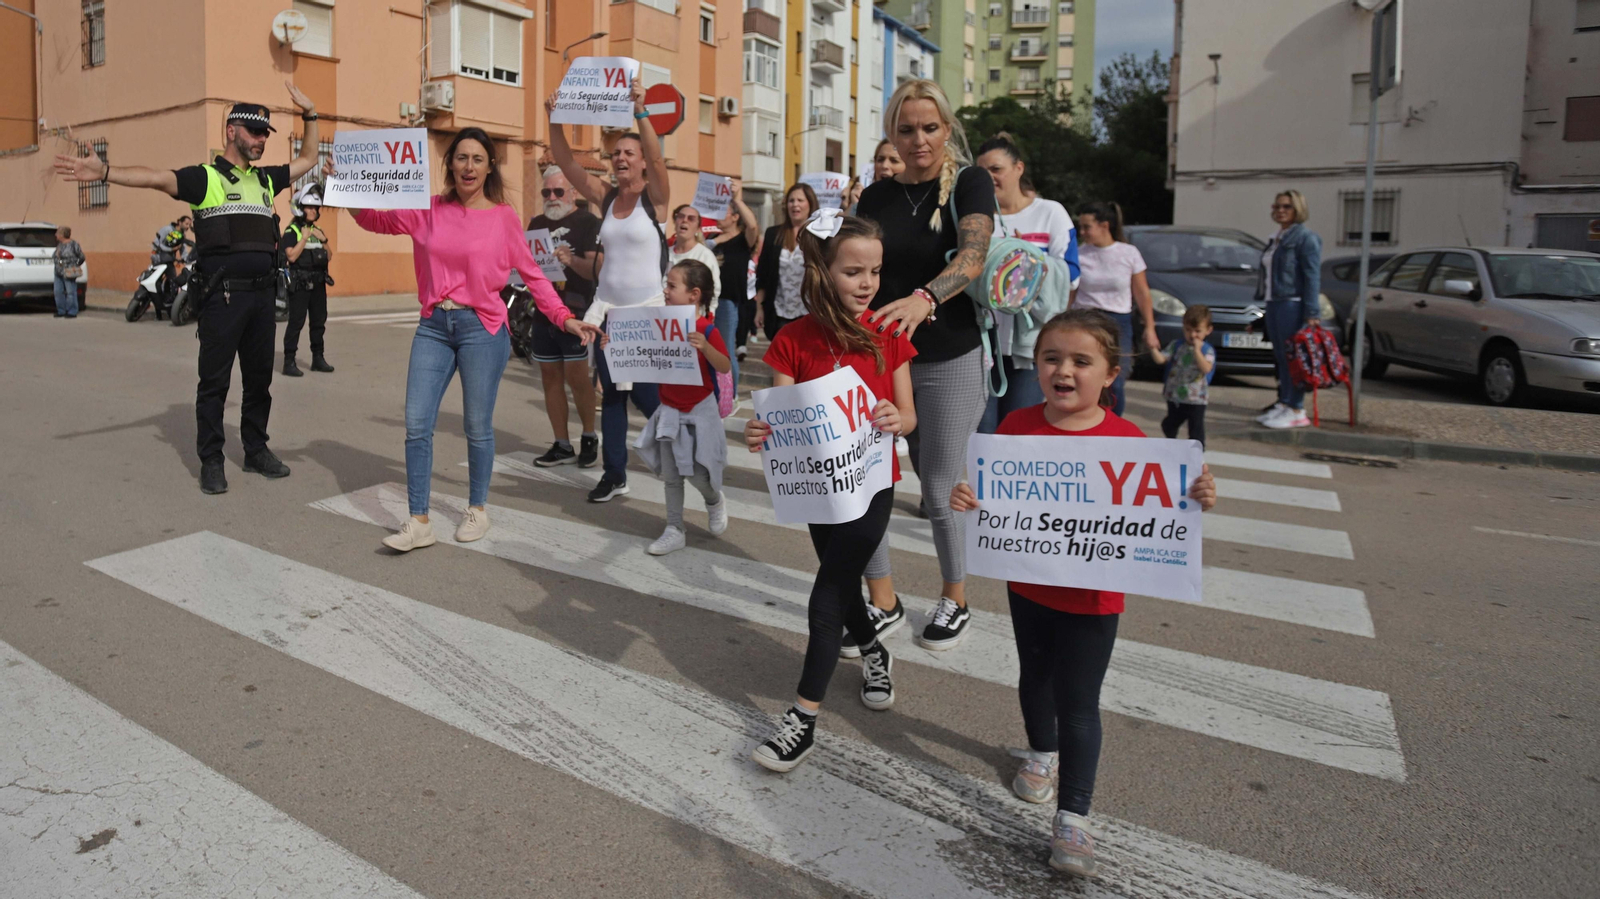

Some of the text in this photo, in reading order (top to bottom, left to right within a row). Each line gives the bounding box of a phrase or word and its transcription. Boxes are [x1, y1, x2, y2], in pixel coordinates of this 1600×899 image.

[562, 77, 600, 87] INFANTIL
[556, 90, 568, 99] Por
[569, 90, 577, 100] la
[577, 91, 620, 102] Seguridad
[555, 101, 608, 113] nuestros hij@s
[334, 142, 379, 153] COMEDOR
[384, 141, 422, 165] YA!
[335, 153, 384, 165] INFANTIL
[333, 169, 424, 183] Por la Seguridad de
[332, 182, 371, 192] nuestros
[373, 181, 399, 195] hij@s
[611, 320, 651, 330] COMEDOR
[612, 330, 657, 342] INFANTIL
[610, 346, 692, 358] Por la Seguridad de
[613, 358, 672, 370] nuestros hij@s
[766, 404, 829, 426] COMEDOR
[771, 421, 842, 448] INFANTIL
[770, 458, 792, 476] Por
[794, 456, 806, 474] la
[807, 432, 867, 477] Seguridad
[867, 427, 882, 447] de
[991, 460, 1086, 478] COMEDOR
[777, 479, 828, 496] nuestros
[831, 465, 866, 494] hij@s
[1099, 460, 1188, 510] YA!
[991, 480, 1095, 503] INFANTIL
[978, 509, 1187, 541] Por la Seguridad de
[978, 535, 1126, 562] nuestros hij@s
[1133, 547, 1188, 558] AMPA ICA CEIP
[1162, 558, 1187, 566] Católica
